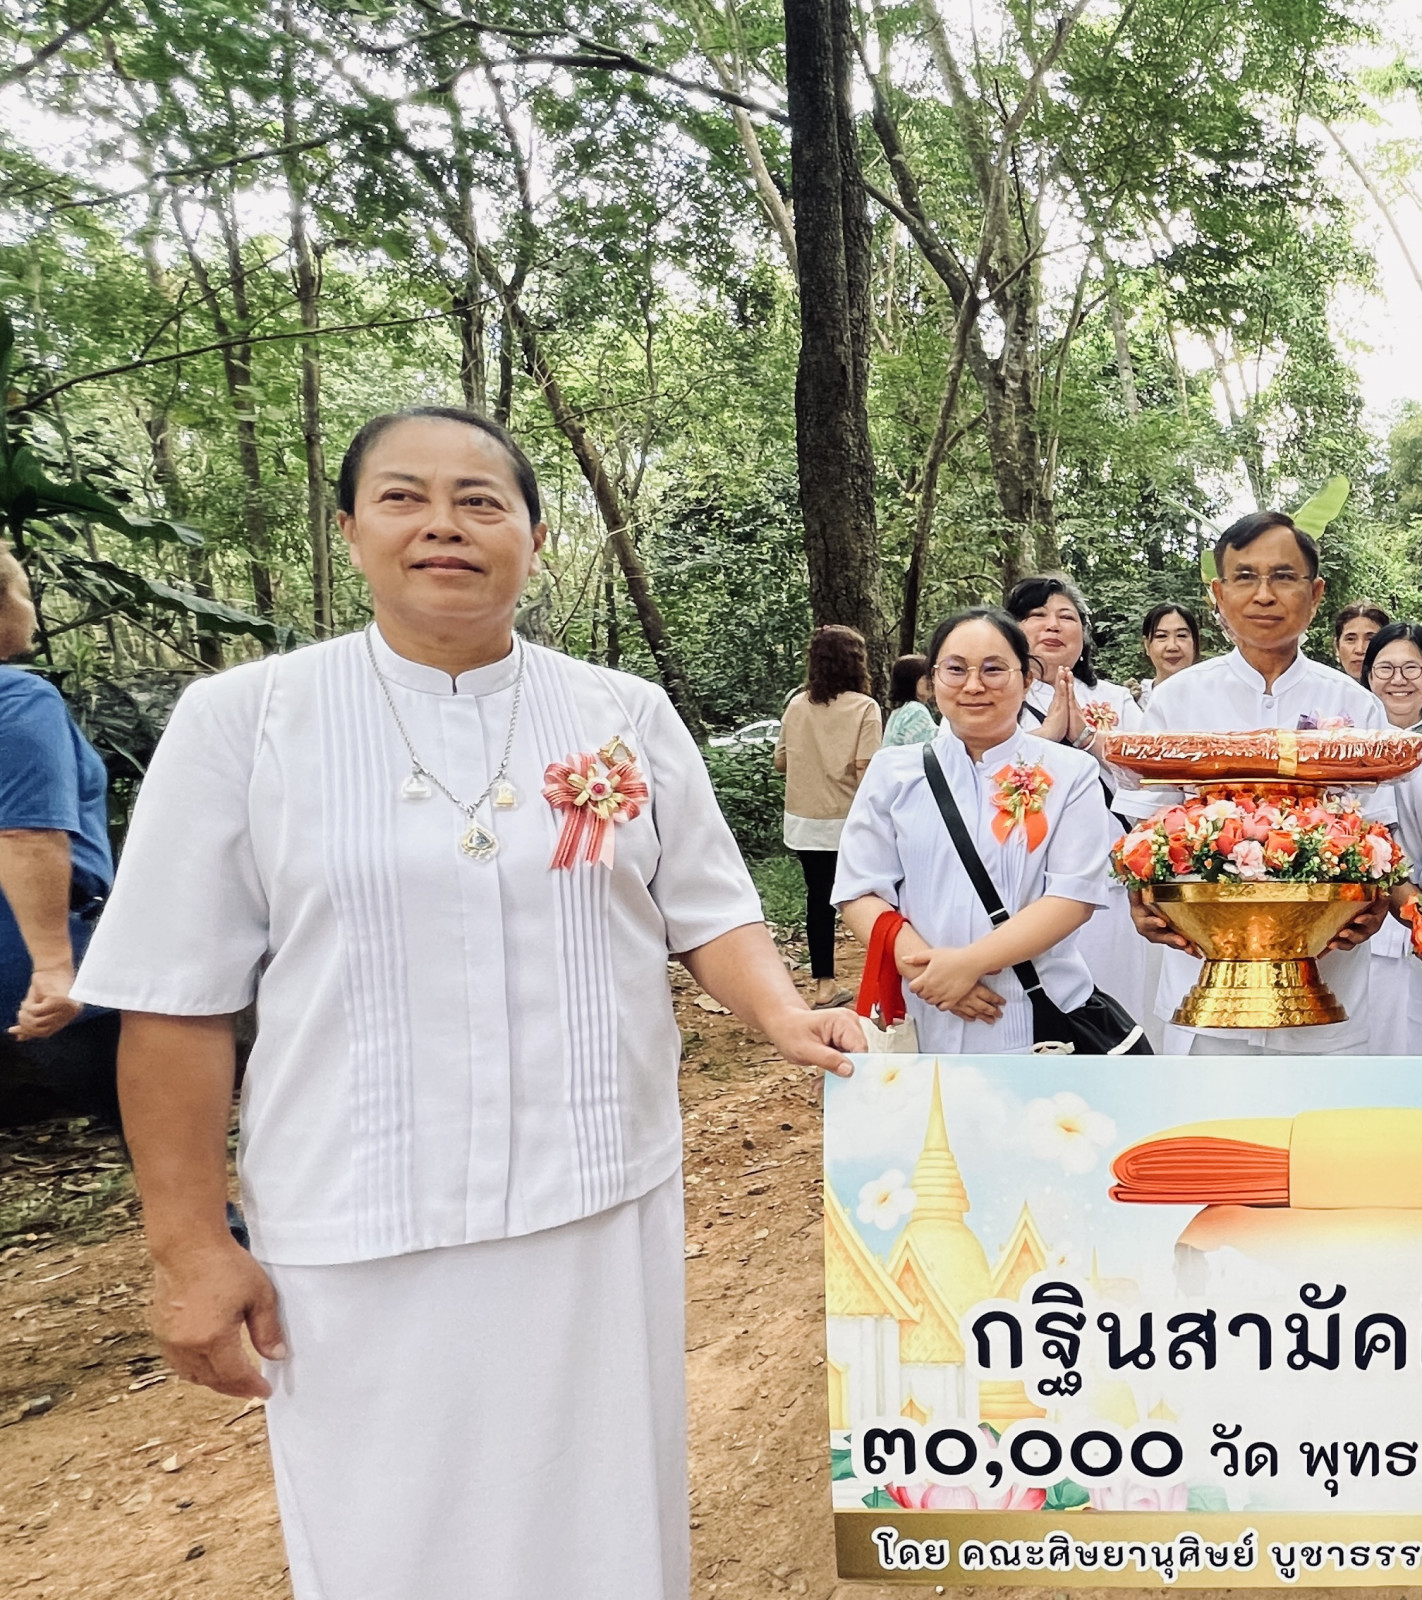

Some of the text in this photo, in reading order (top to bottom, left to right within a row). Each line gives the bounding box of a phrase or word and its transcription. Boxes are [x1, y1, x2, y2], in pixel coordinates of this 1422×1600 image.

[863, 1428, 1184, 1488] ๓๐,๐๐๐
[1210, 1423, 1278, 1478] วัด
[876, 1532, 946, 1566] โดย
[964, 1532, 1254, 1579] คณะศิษยานุศิษย์
